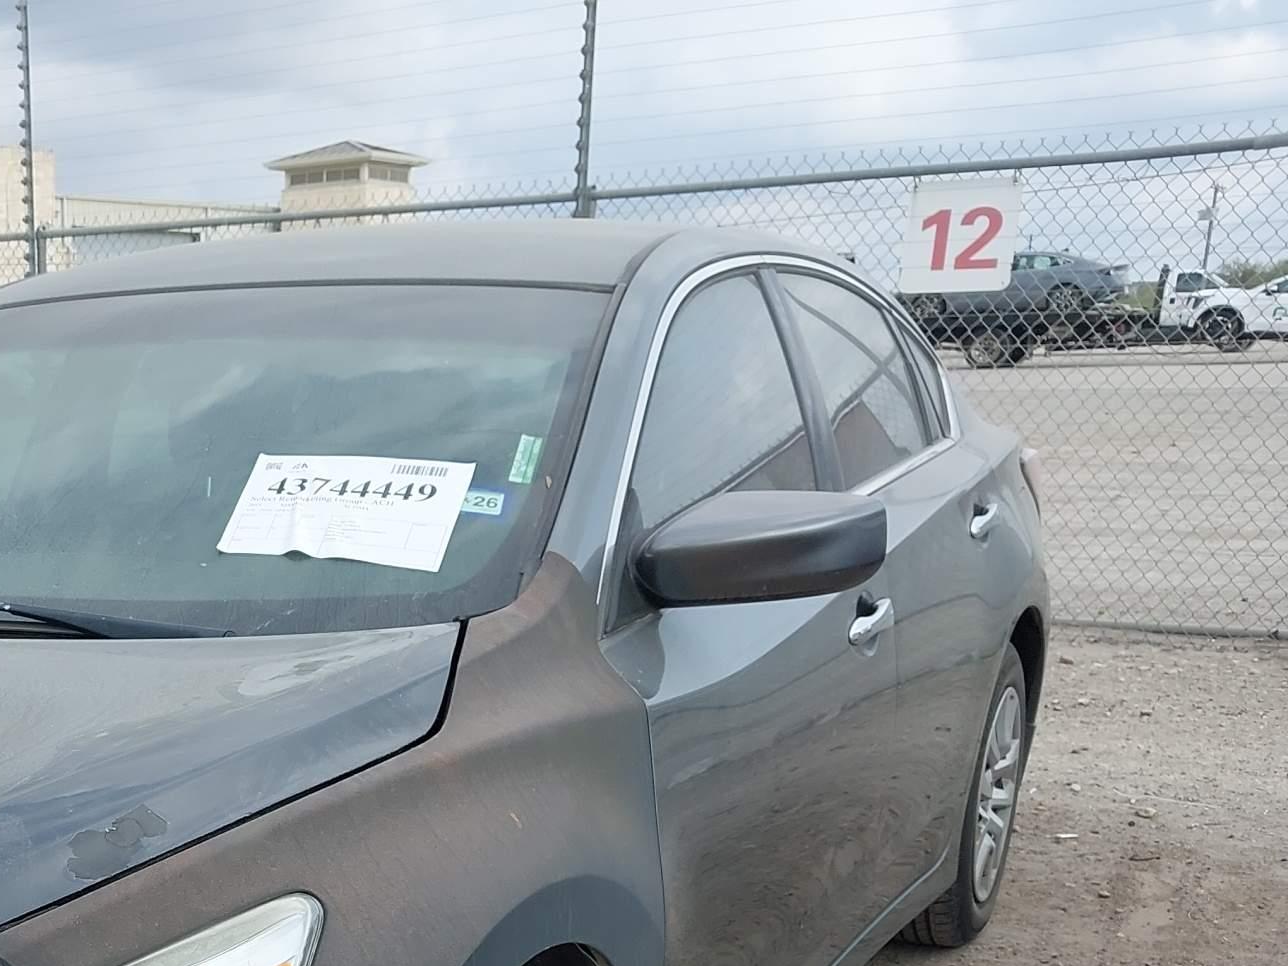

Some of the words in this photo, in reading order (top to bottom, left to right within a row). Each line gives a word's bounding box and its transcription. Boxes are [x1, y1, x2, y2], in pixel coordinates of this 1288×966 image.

[921, 206, 1004, 271] 12
[267, 477, 438, 503] 43744449
[473, 496, 498, 509] 26
